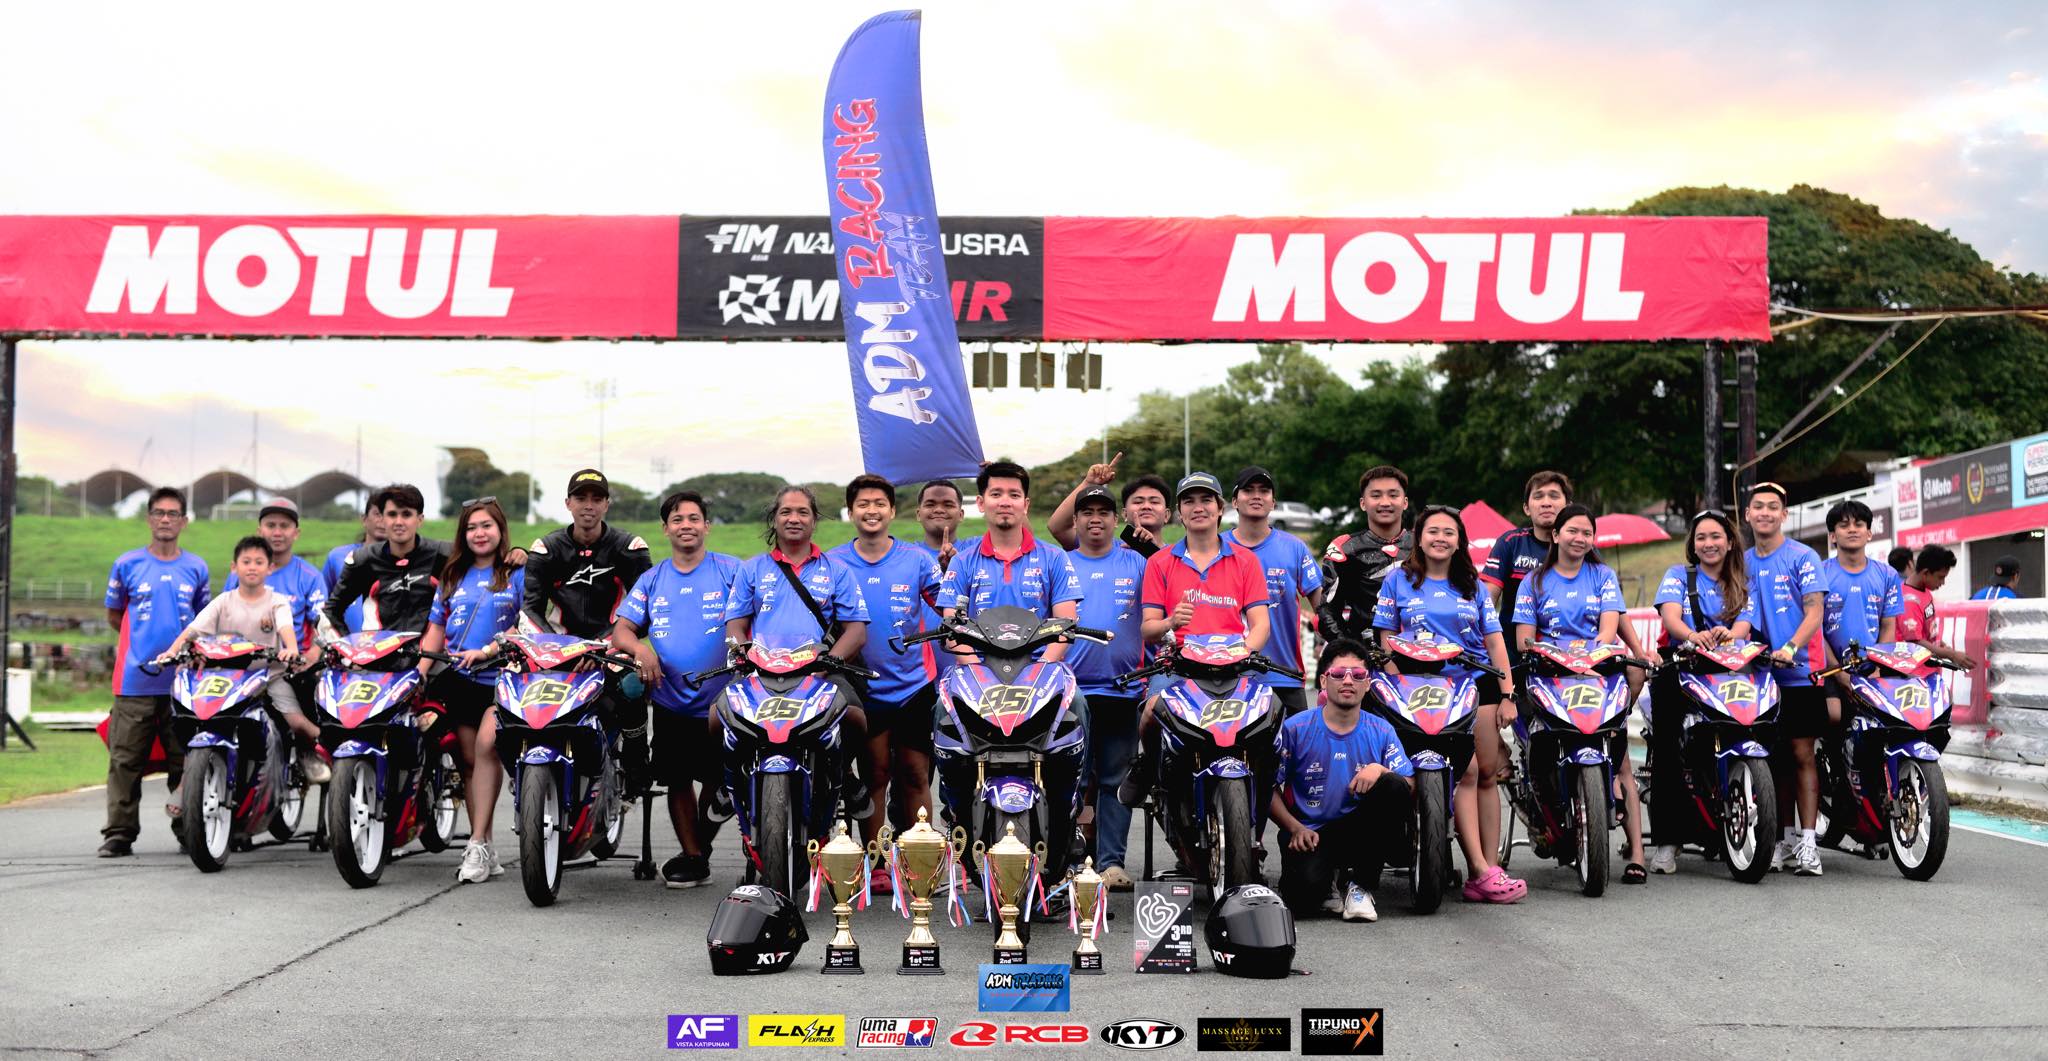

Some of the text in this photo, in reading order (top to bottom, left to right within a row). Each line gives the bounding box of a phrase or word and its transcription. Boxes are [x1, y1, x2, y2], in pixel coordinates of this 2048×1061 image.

[705, 224, 779, 253] FIM
[86, 225, 514, 319] MOTUL
[833, 98, 938, 425] ADM RACING
[1212, 231, 1645, 323] MOTUL
[1515, 555, 1538, 568] ADM
[197, 676, 231, 695] 13
[341, 680, 380, 703] 13
[522, 679, 571, 705] 95
[1564, 685, 1603, 707] 12
[1719, 681, 1757, 701] 12
[755, 697, 805, 720] 95
[979, 685, 1035, 715] 95
[1407, 686, 1450, 711] 99
[1201, 700, 1246, 724] 99
[757, 951, 791, 965] KYT
[1212, 949, 1236, 965] KYT
